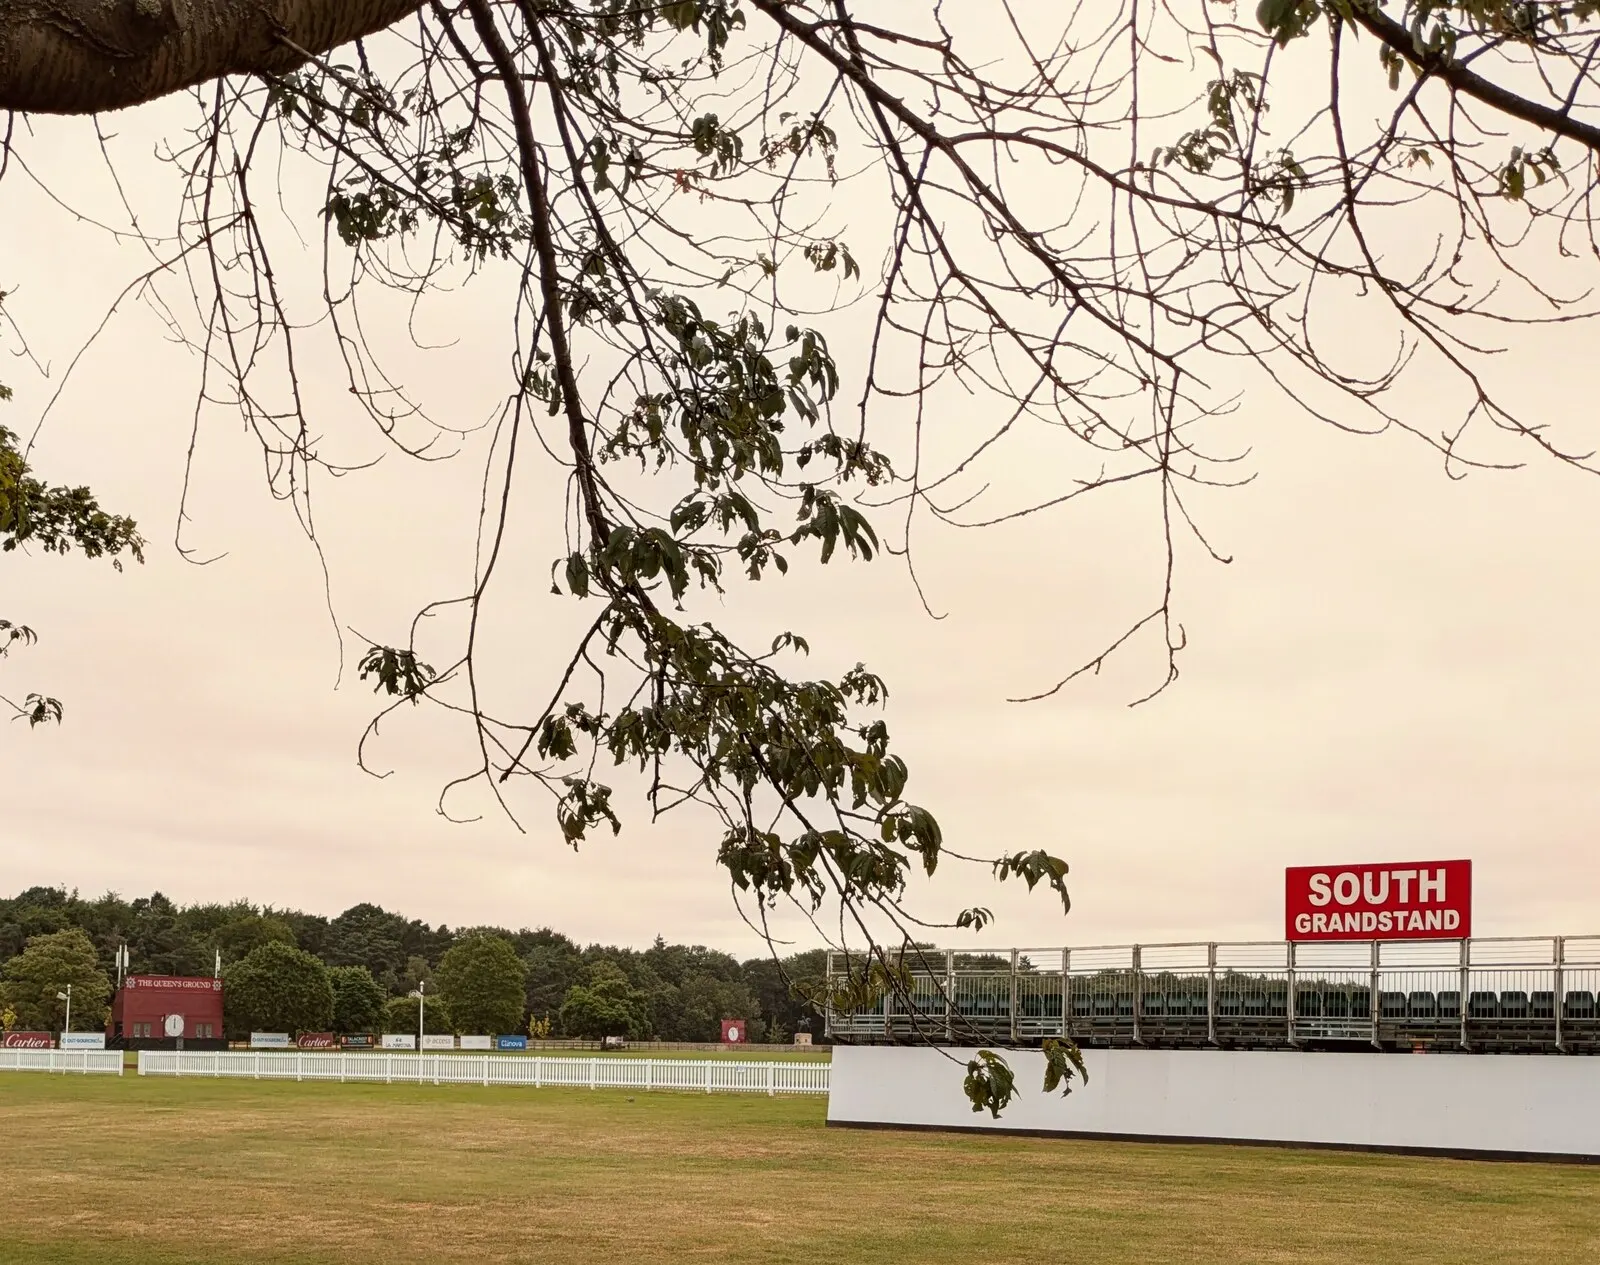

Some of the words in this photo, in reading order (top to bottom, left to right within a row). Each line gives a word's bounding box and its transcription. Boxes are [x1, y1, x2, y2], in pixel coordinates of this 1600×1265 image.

[1308, 868, 1447, 907] SOUTH
[1295, 909, 1460, 933] GRANDSTAND
[138, 979, 153, 987] THE
[153, 980, 182, 988] QUEEN'S
[182, 981, 211, 989] GROUND
[5, 1033, 49, 1048] Cartier
[298, 1034, 331, 1047] Cartier
